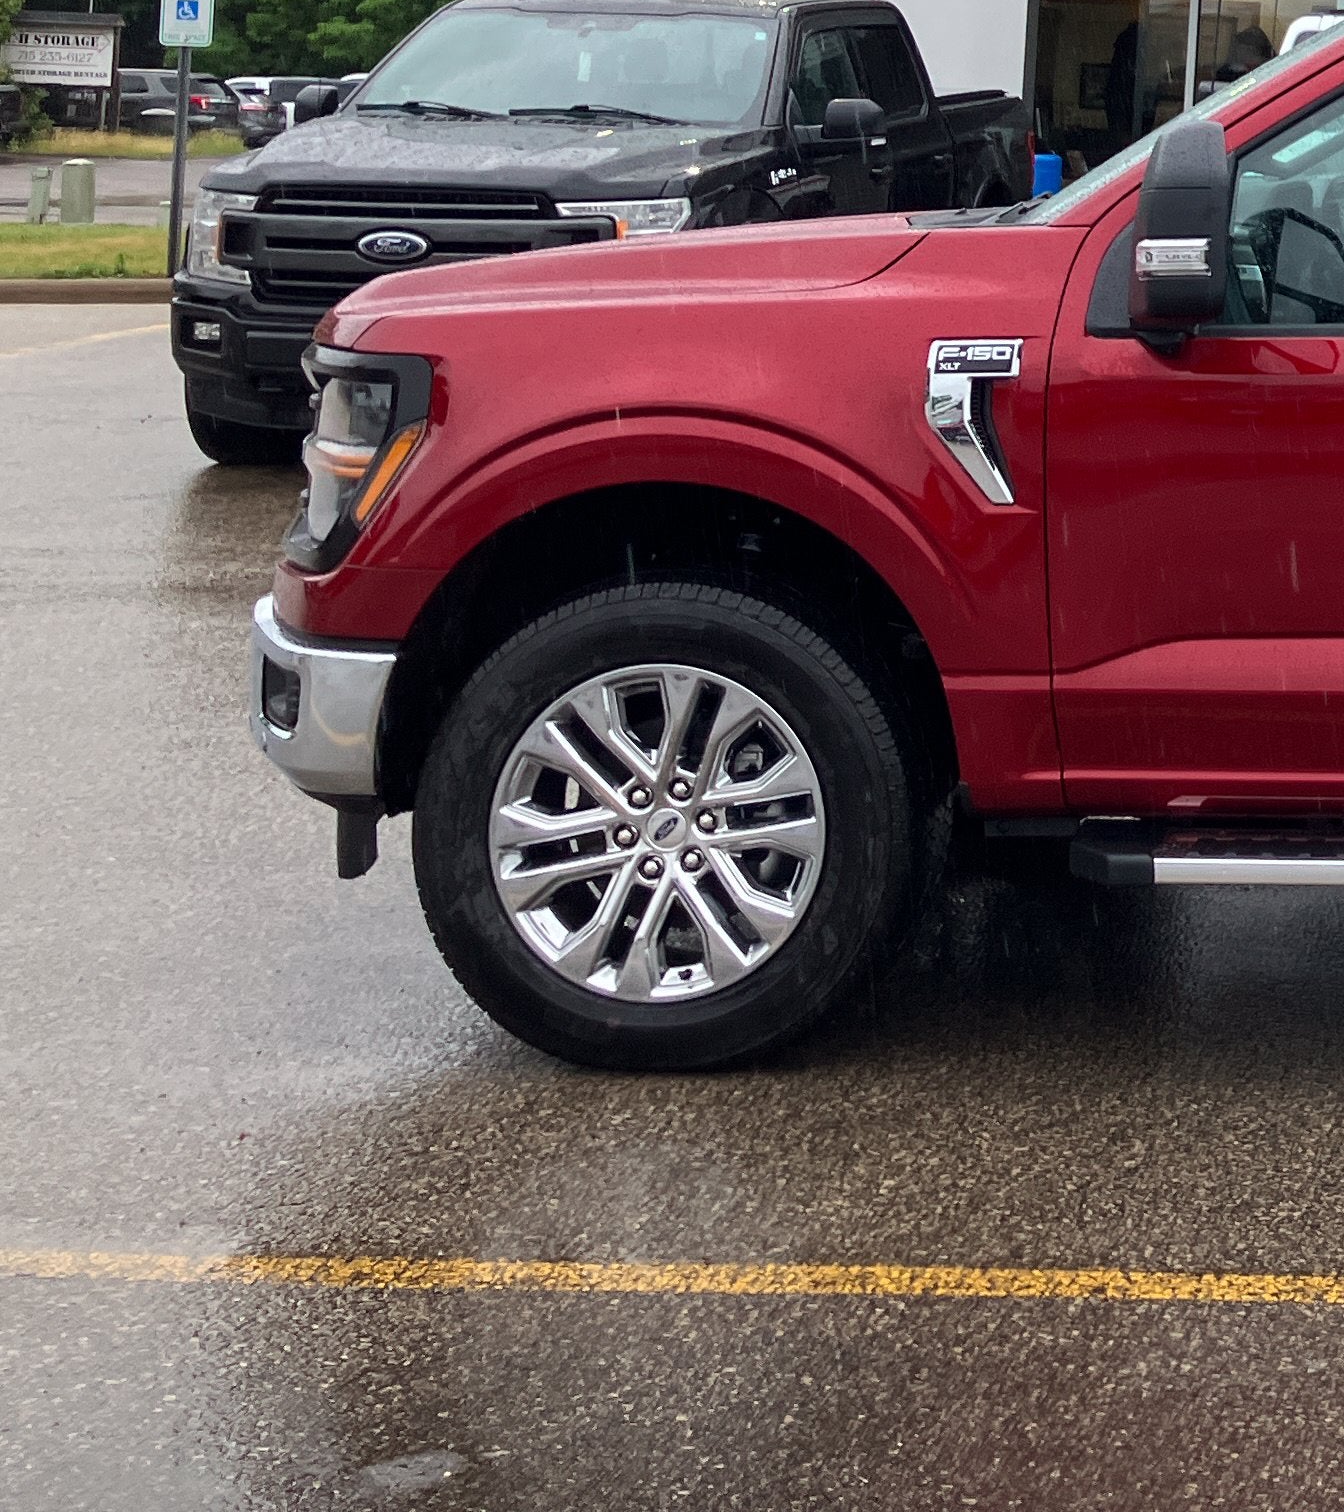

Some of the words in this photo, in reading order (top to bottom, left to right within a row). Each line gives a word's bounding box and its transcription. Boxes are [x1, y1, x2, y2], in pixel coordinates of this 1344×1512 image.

[34, 35, 99, 47] STORAGE
[938, 346, 1012, 361] F-150
[938, 362, 961, 370] XLT
